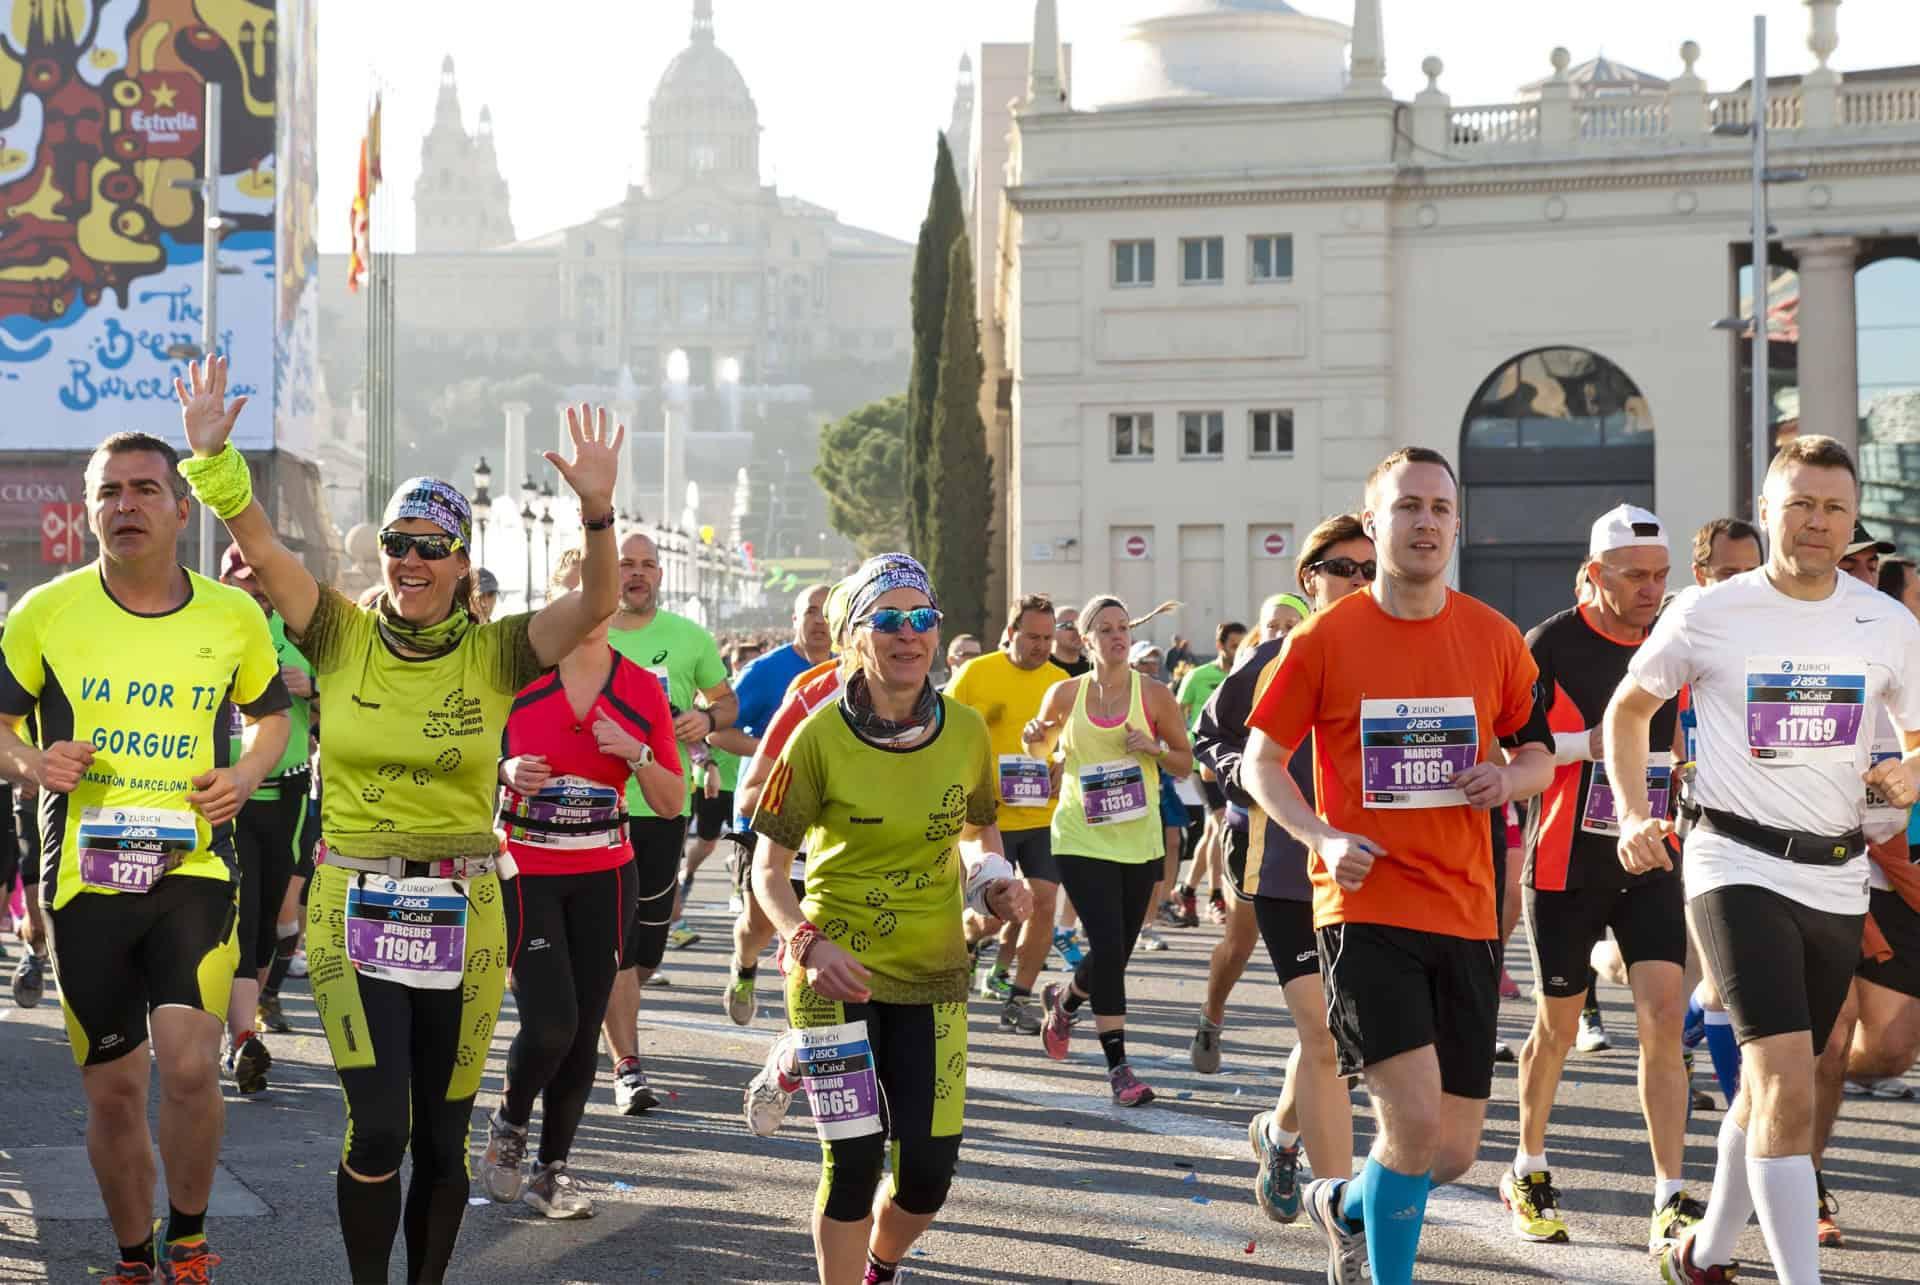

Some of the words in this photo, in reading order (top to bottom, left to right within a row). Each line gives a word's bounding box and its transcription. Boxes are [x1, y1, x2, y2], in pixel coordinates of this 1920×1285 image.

[131, 110, 197, 131] Estrella
[140, 284, 202, 321] The
[1797, 663, 1830, 672] ZURICH
[1801, 677, 1827, 686] asics
[82, 676, 111, 703] VA
[126, 681, 175, 709] POR
[192, 687, 216, 710] TI
[1412, 705, 1445, 714] ZURICH
[1416, 719, 1442, 729] asics
[1776, 717, 1837, 741] 11769
[92, 727, 199, 760] GORGUE!
[1403, 748, 1443, 759] MARCUS
[1392, 760, 1454, 785] 11869
[130, 777, 188, 792] BARCELONA
[128, 815, 161, 824] ZURICH
[118, 853, 158, 865] ANTONIO
[400, 883, 434, 894] ZURICH
[403, 896, 430, 908] asics
[384, 923, 432, 938] MERCEDES
[374, 936, 437, 964] 11964
[816, 1047, 839, 1059] asics
